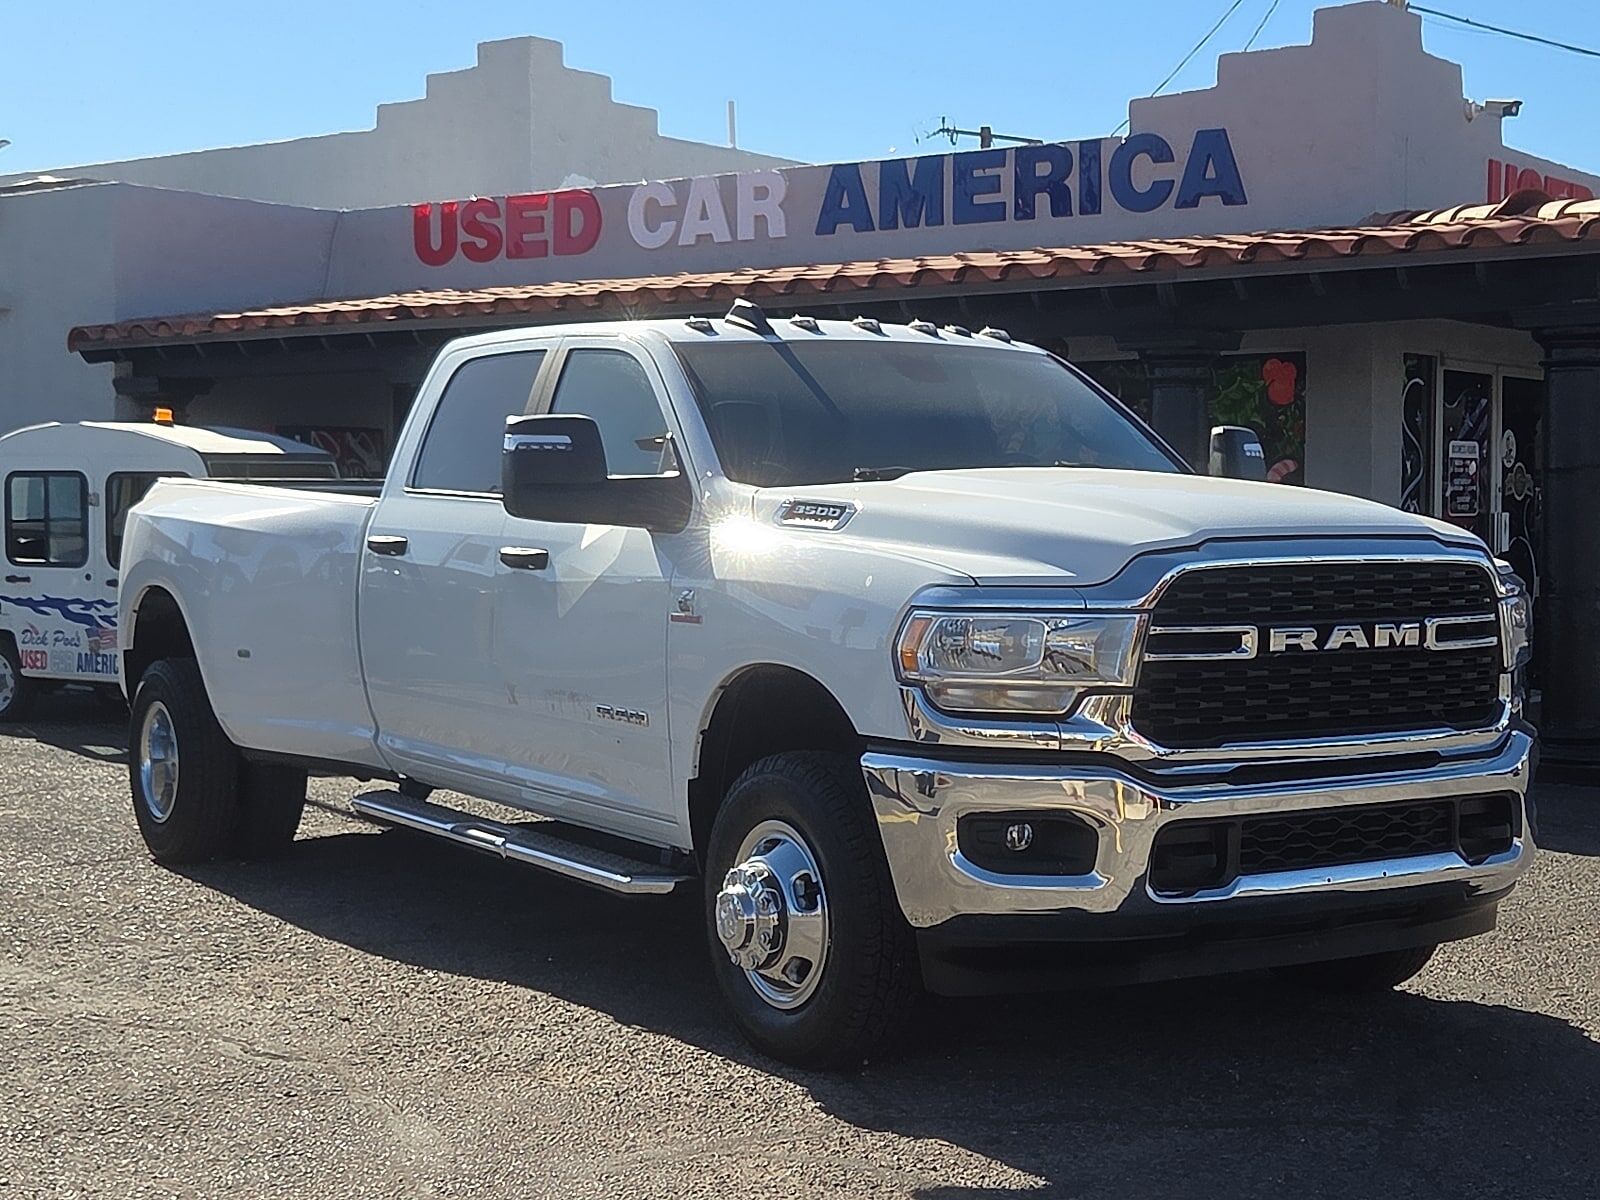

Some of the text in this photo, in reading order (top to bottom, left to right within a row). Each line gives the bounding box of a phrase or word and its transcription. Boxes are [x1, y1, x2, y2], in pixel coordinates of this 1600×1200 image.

[413, 128, 1248, 267] USED CAR AMERICA
[792, 504, 841, 518] 3500
[21, 628, 49, 647] Dick
[1269, 622, 1420, 653] RAM
[20, 649, 48, 670] USED
[76, 651, 119, 675] AMERIC
